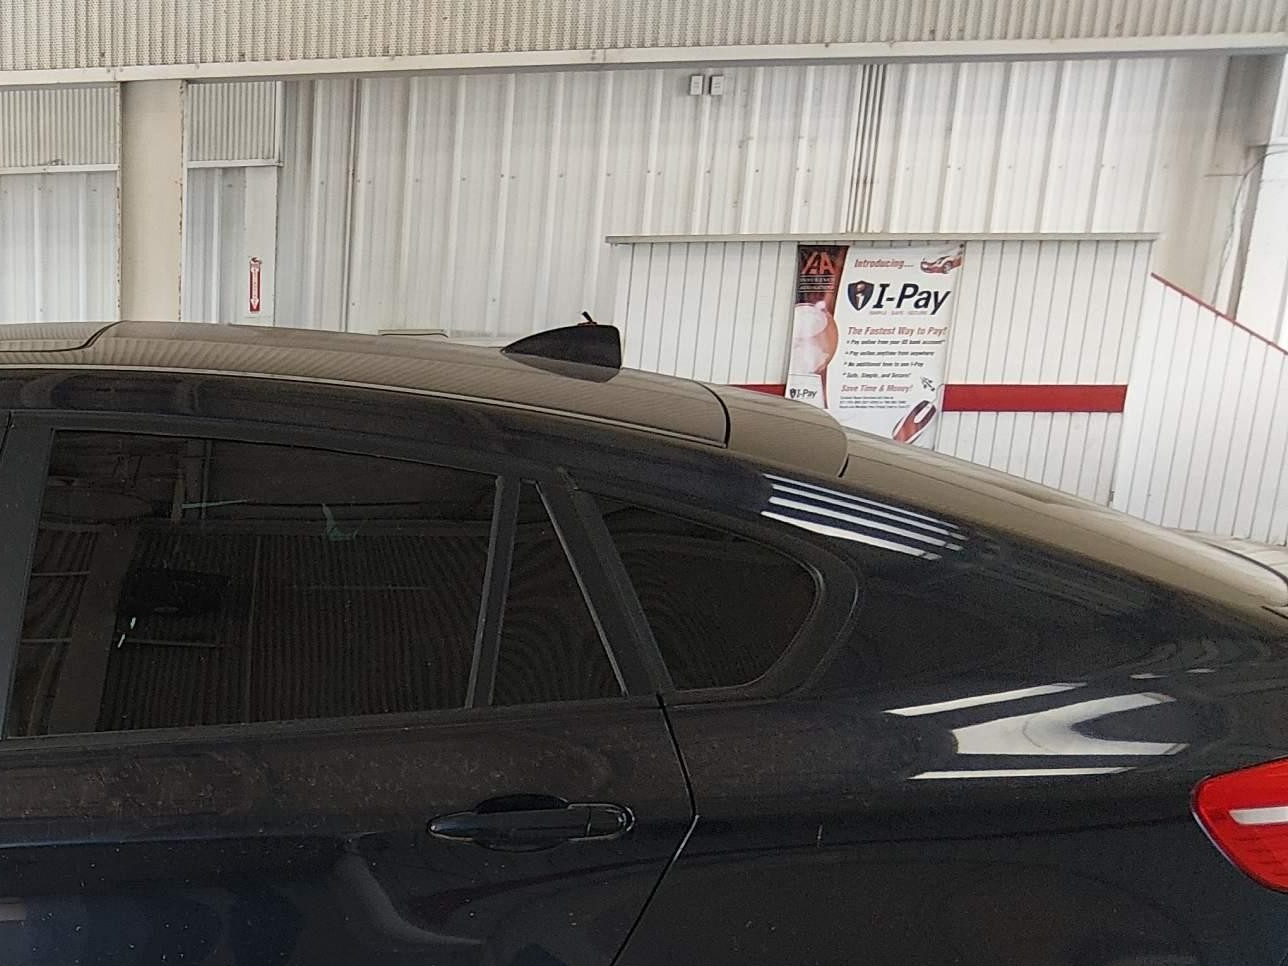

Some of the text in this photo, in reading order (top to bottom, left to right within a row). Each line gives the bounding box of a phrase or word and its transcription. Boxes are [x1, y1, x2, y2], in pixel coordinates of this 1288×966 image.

[872, 283, 952, 315] I-Pay
[847, 326, 863, 336] The
[864, 326, 895, 336] Fastest
[898, 326, 914, 337] Way
[917, 327, 926, 335] to
[796, 388, 818, 399] I-Pay
[840, 384, 859, 392] Save
[860, 384, 878, 392] Time
[878, 384, 886, 392] &
